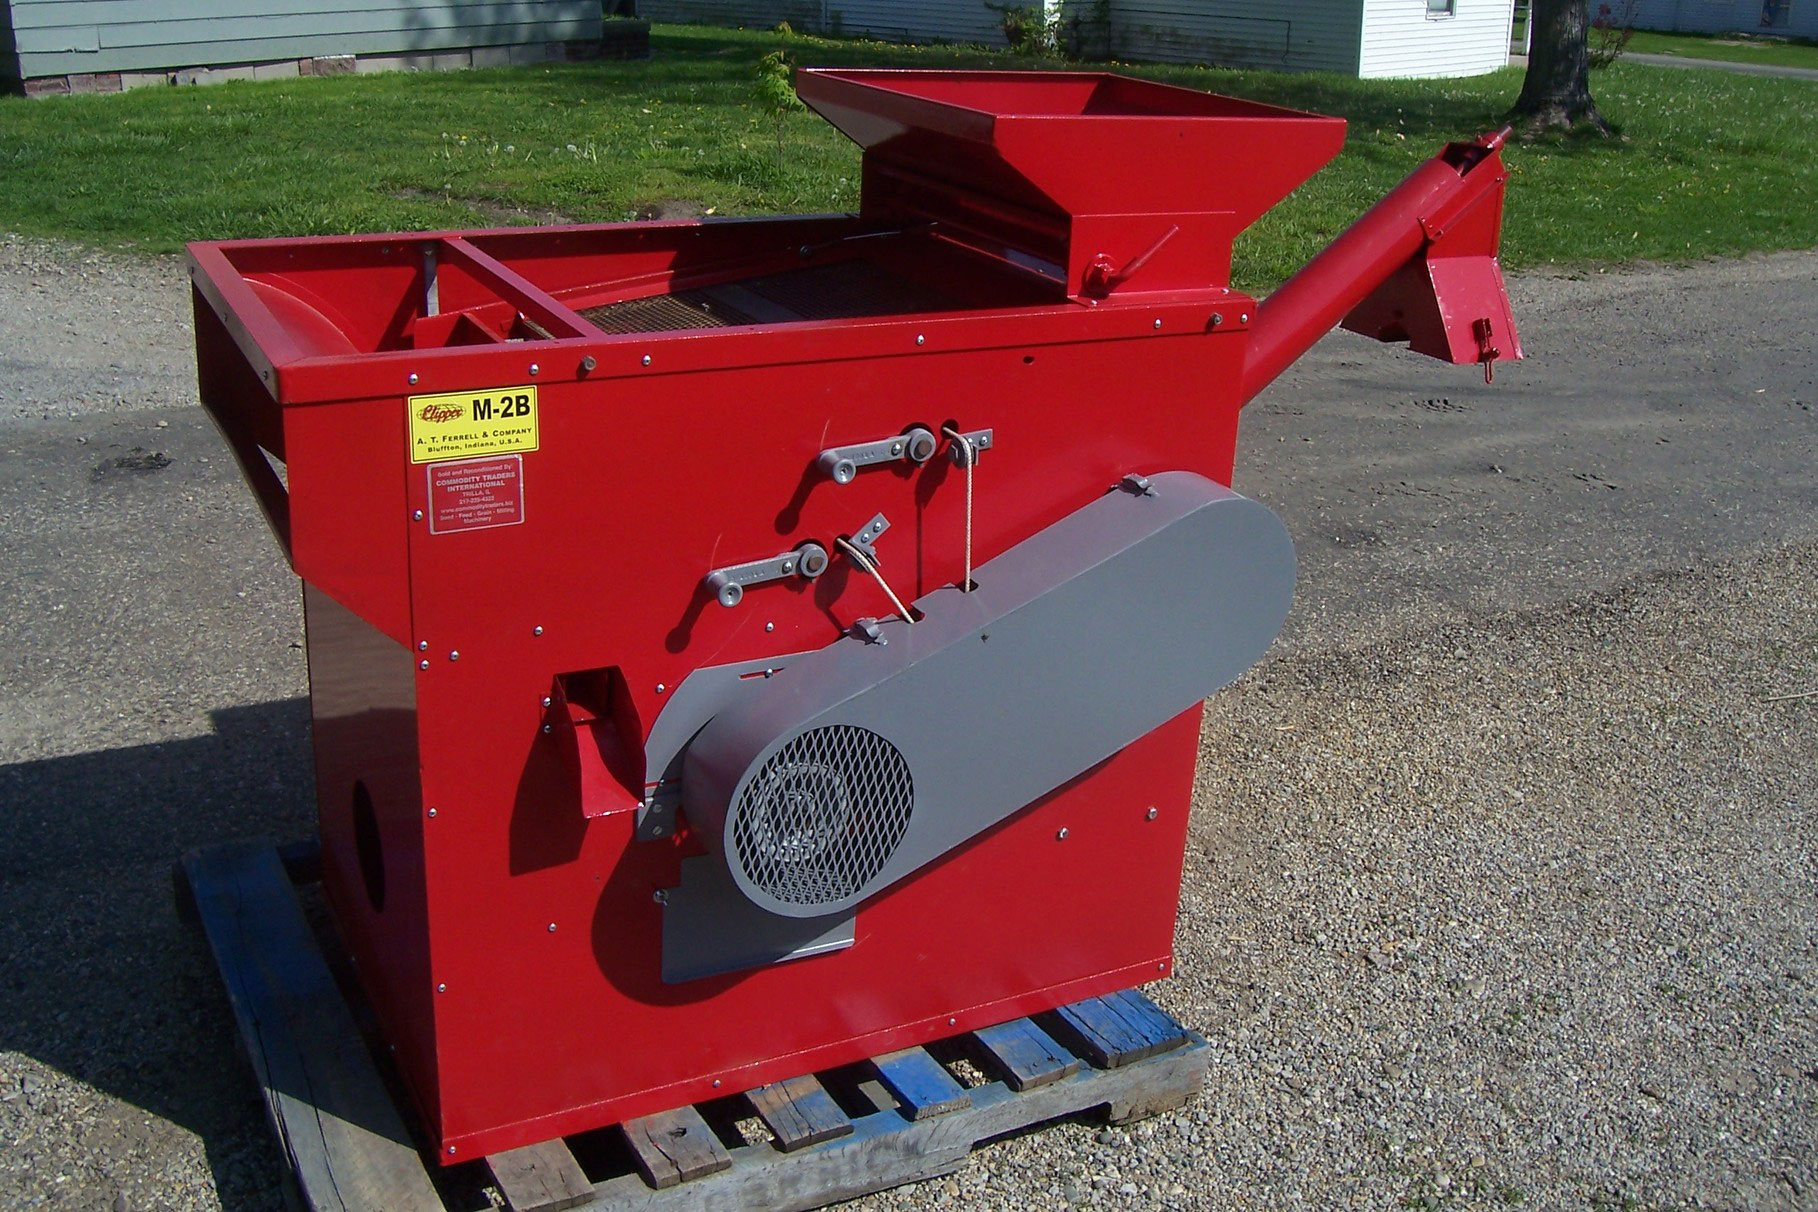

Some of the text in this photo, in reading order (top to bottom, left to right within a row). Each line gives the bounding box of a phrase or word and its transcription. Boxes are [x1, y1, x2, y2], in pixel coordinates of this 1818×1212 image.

[422, 404, 464, 423] Clipper
[472, 395, 531, 421] M-2B
[442, 433, 479, 442] FERRELL
[492, 427, 532, 437] COMPANY
[427, 444, 462, 453] Bluffton,
[464, 441, 497, 449] Indiana,
[436, 471, 516, 486] COMMODITY TRADERS
[447, 480, 506, 492] INTERNATIONAL
